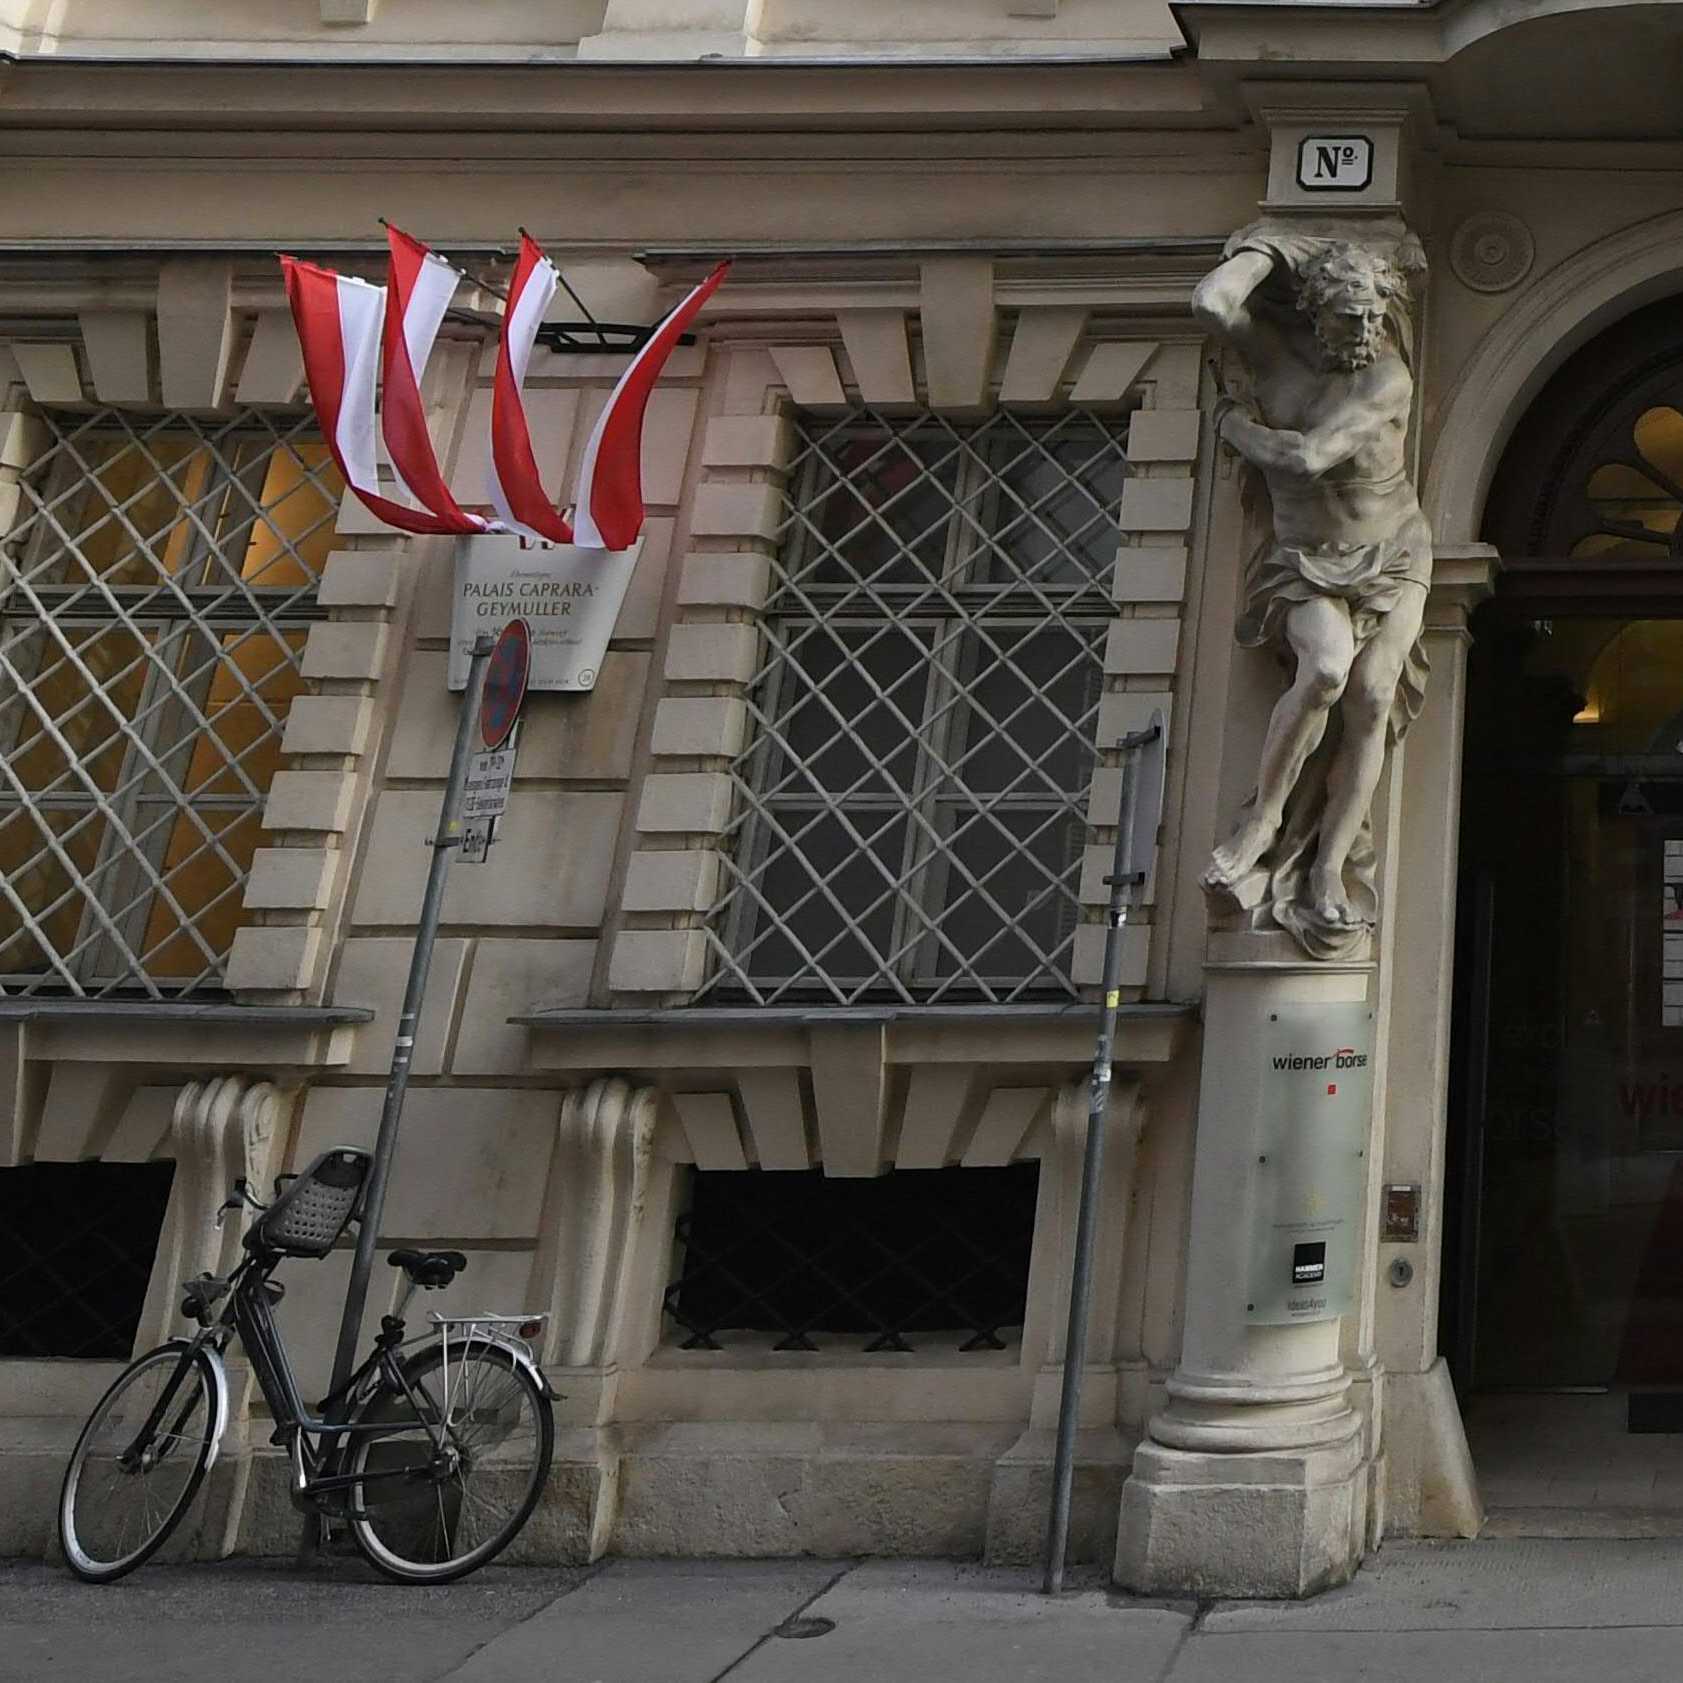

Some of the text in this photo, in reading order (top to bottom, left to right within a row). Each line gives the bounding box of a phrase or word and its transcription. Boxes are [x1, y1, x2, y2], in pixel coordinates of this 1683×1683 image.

[463, 582, 600, 597] PALAIS CAPRARA-
[1272, 1053, 1330, 1071] wiener
